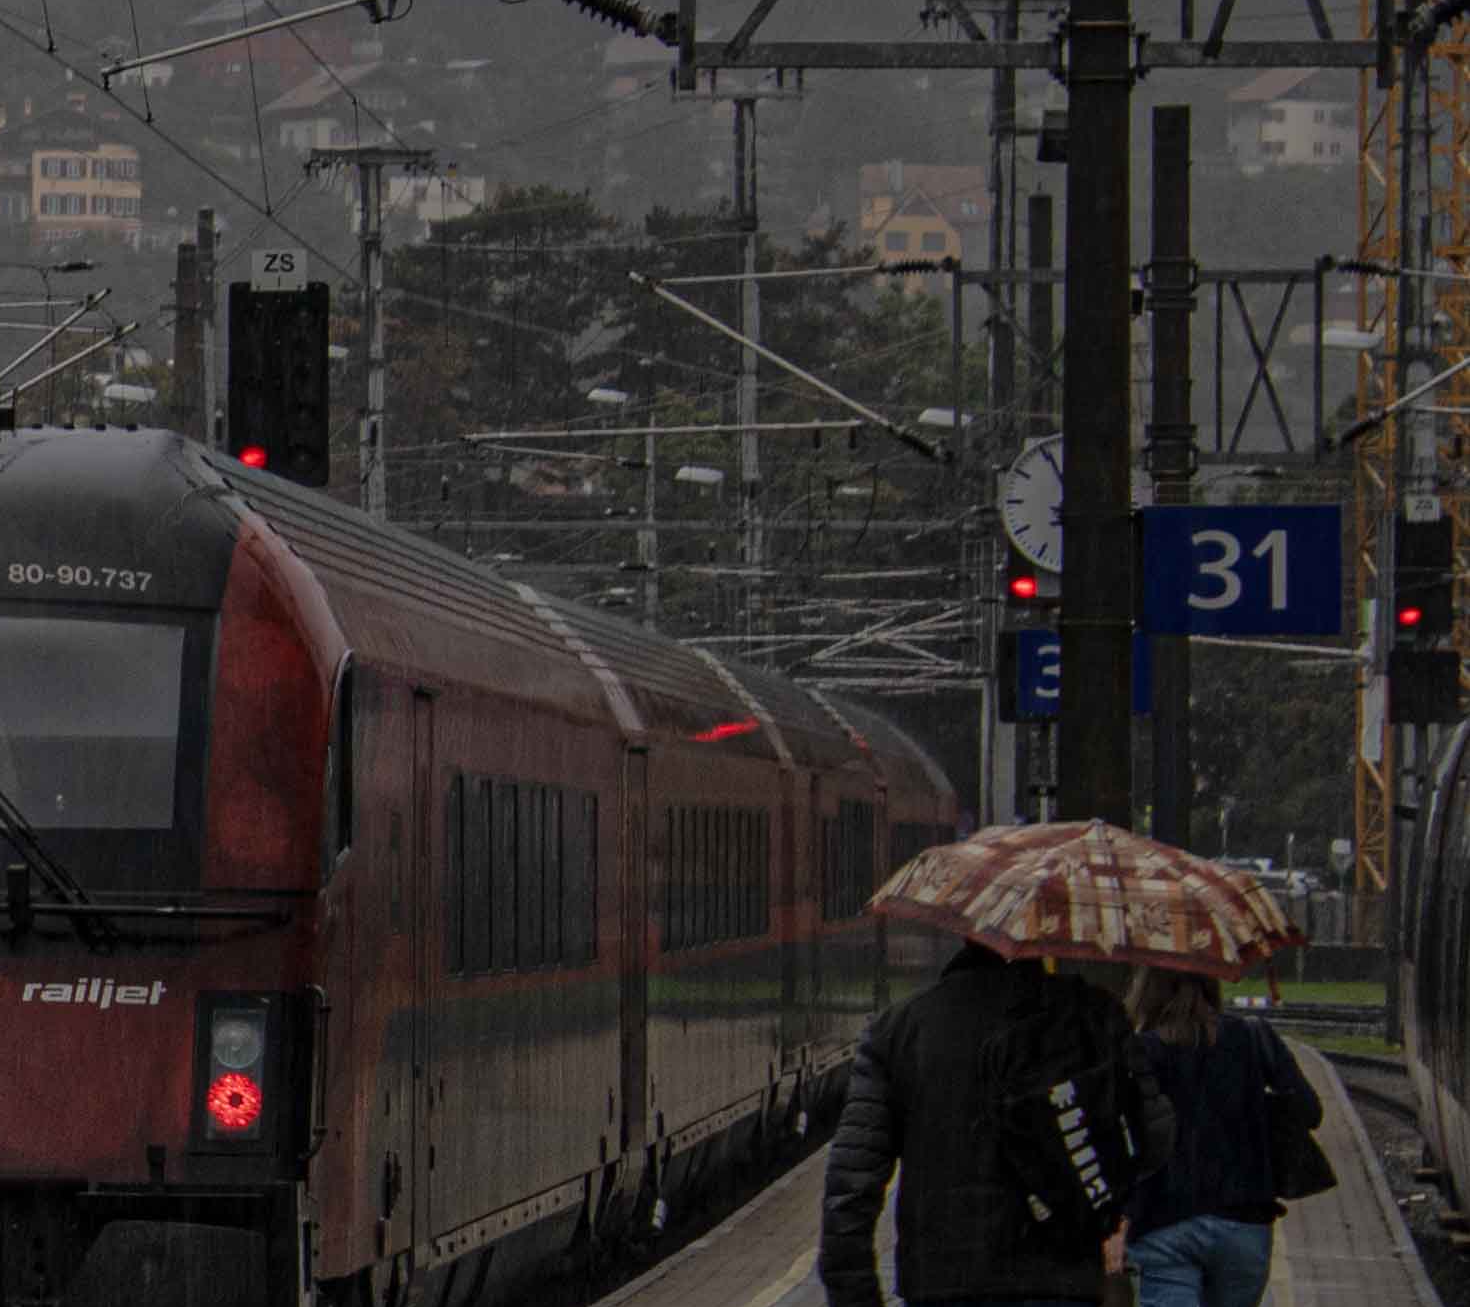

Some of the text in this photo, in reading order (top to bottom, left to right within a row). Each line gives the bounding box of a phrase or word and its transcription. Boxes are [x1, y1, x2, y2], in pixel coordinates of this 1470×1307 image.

[7, 562, 154, 593] 80-90.737
[1186, 528, 1289, 612] 31
[21, 976, 168, 1011] railjet
